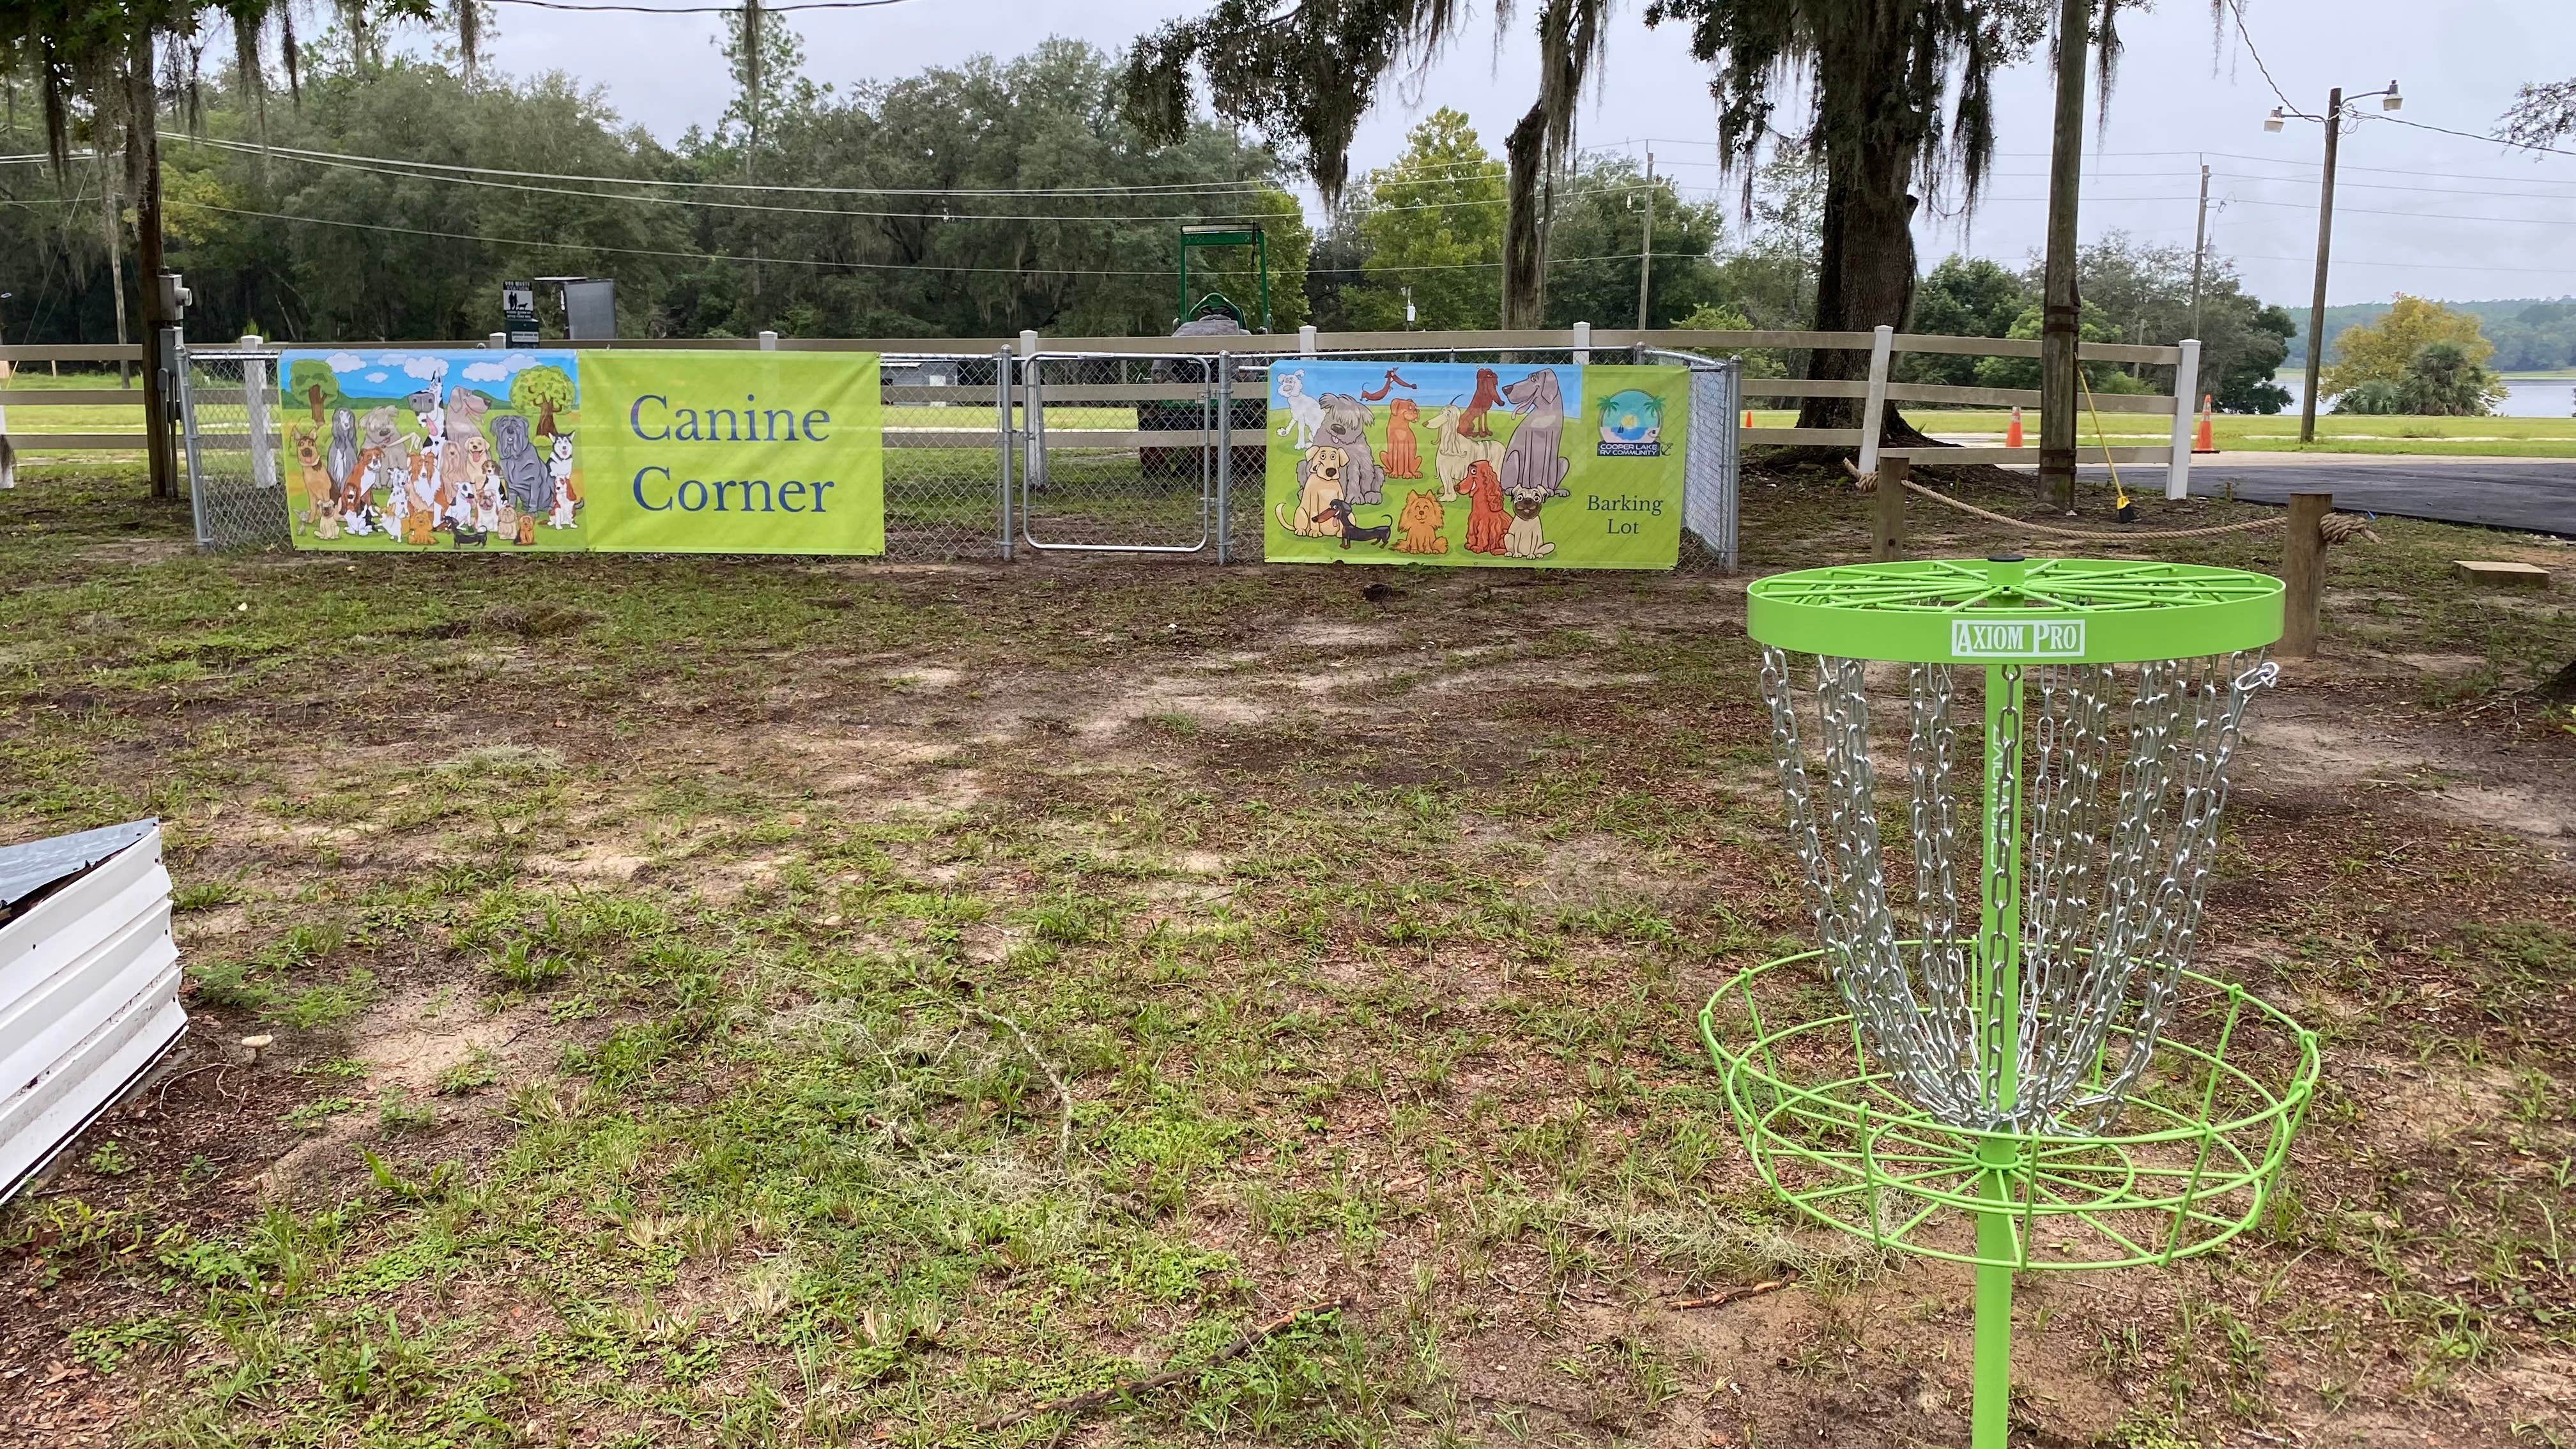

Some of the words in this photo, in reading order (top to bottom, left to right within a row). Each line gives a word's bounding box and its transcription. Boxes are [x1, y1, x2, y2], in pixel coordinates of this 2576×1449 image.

[630, 394, 831, 441] Canine
[632, 466, 835, 512] Corner
[1586, 494, 1664, 516] Barking
[1607, 518, 1639, 534] Lot
[1958, 624, 2025, 653] AXIOM
[2034, 624, 2078, 653] PRO
